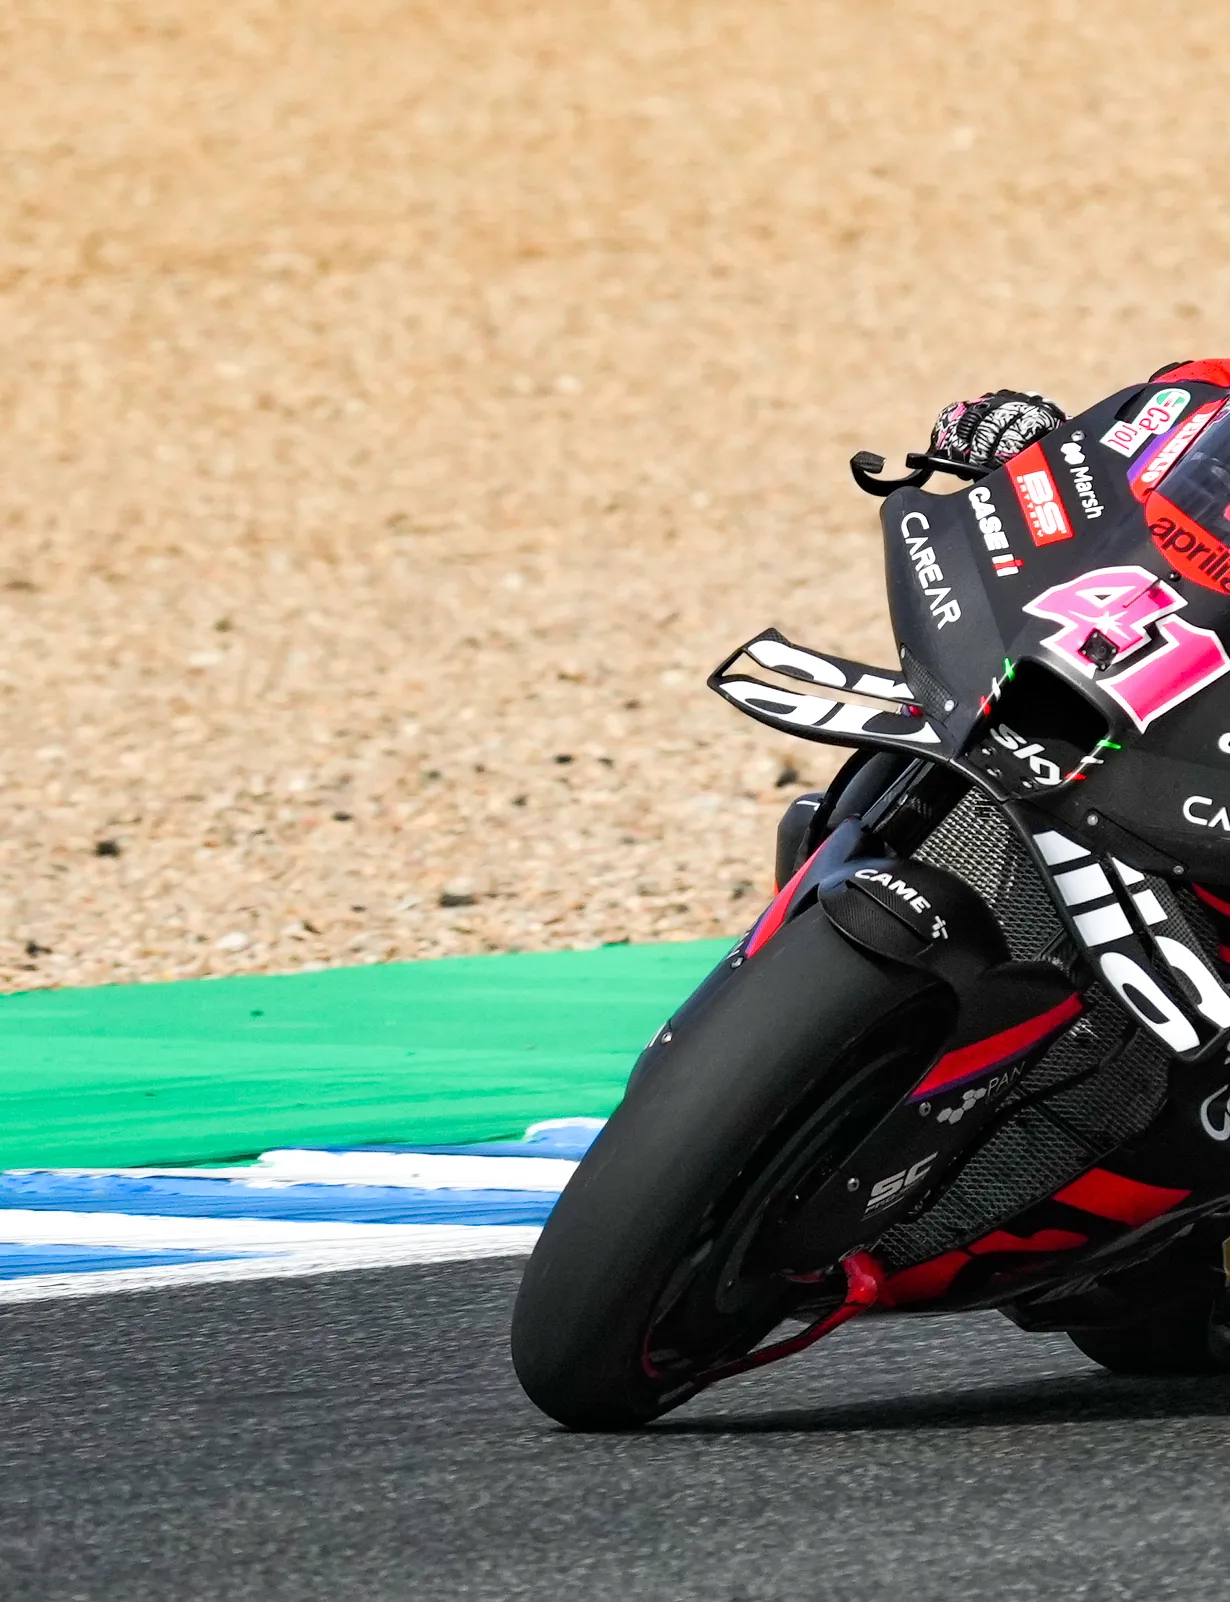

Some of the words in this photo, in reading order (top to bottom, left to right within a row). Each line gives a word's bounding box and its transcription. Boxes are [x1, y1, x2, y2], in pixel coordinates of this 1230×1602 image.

[968, 486, 1010, 555] CASE
[1022, 470, 1066, 535] BS
[1070, 463, 1104, 519] Marsh
[901, 511, 962, 630] CAREAR
[855, 868, 931, 914] CAME
[866, 1151, 940, 1207] SC
